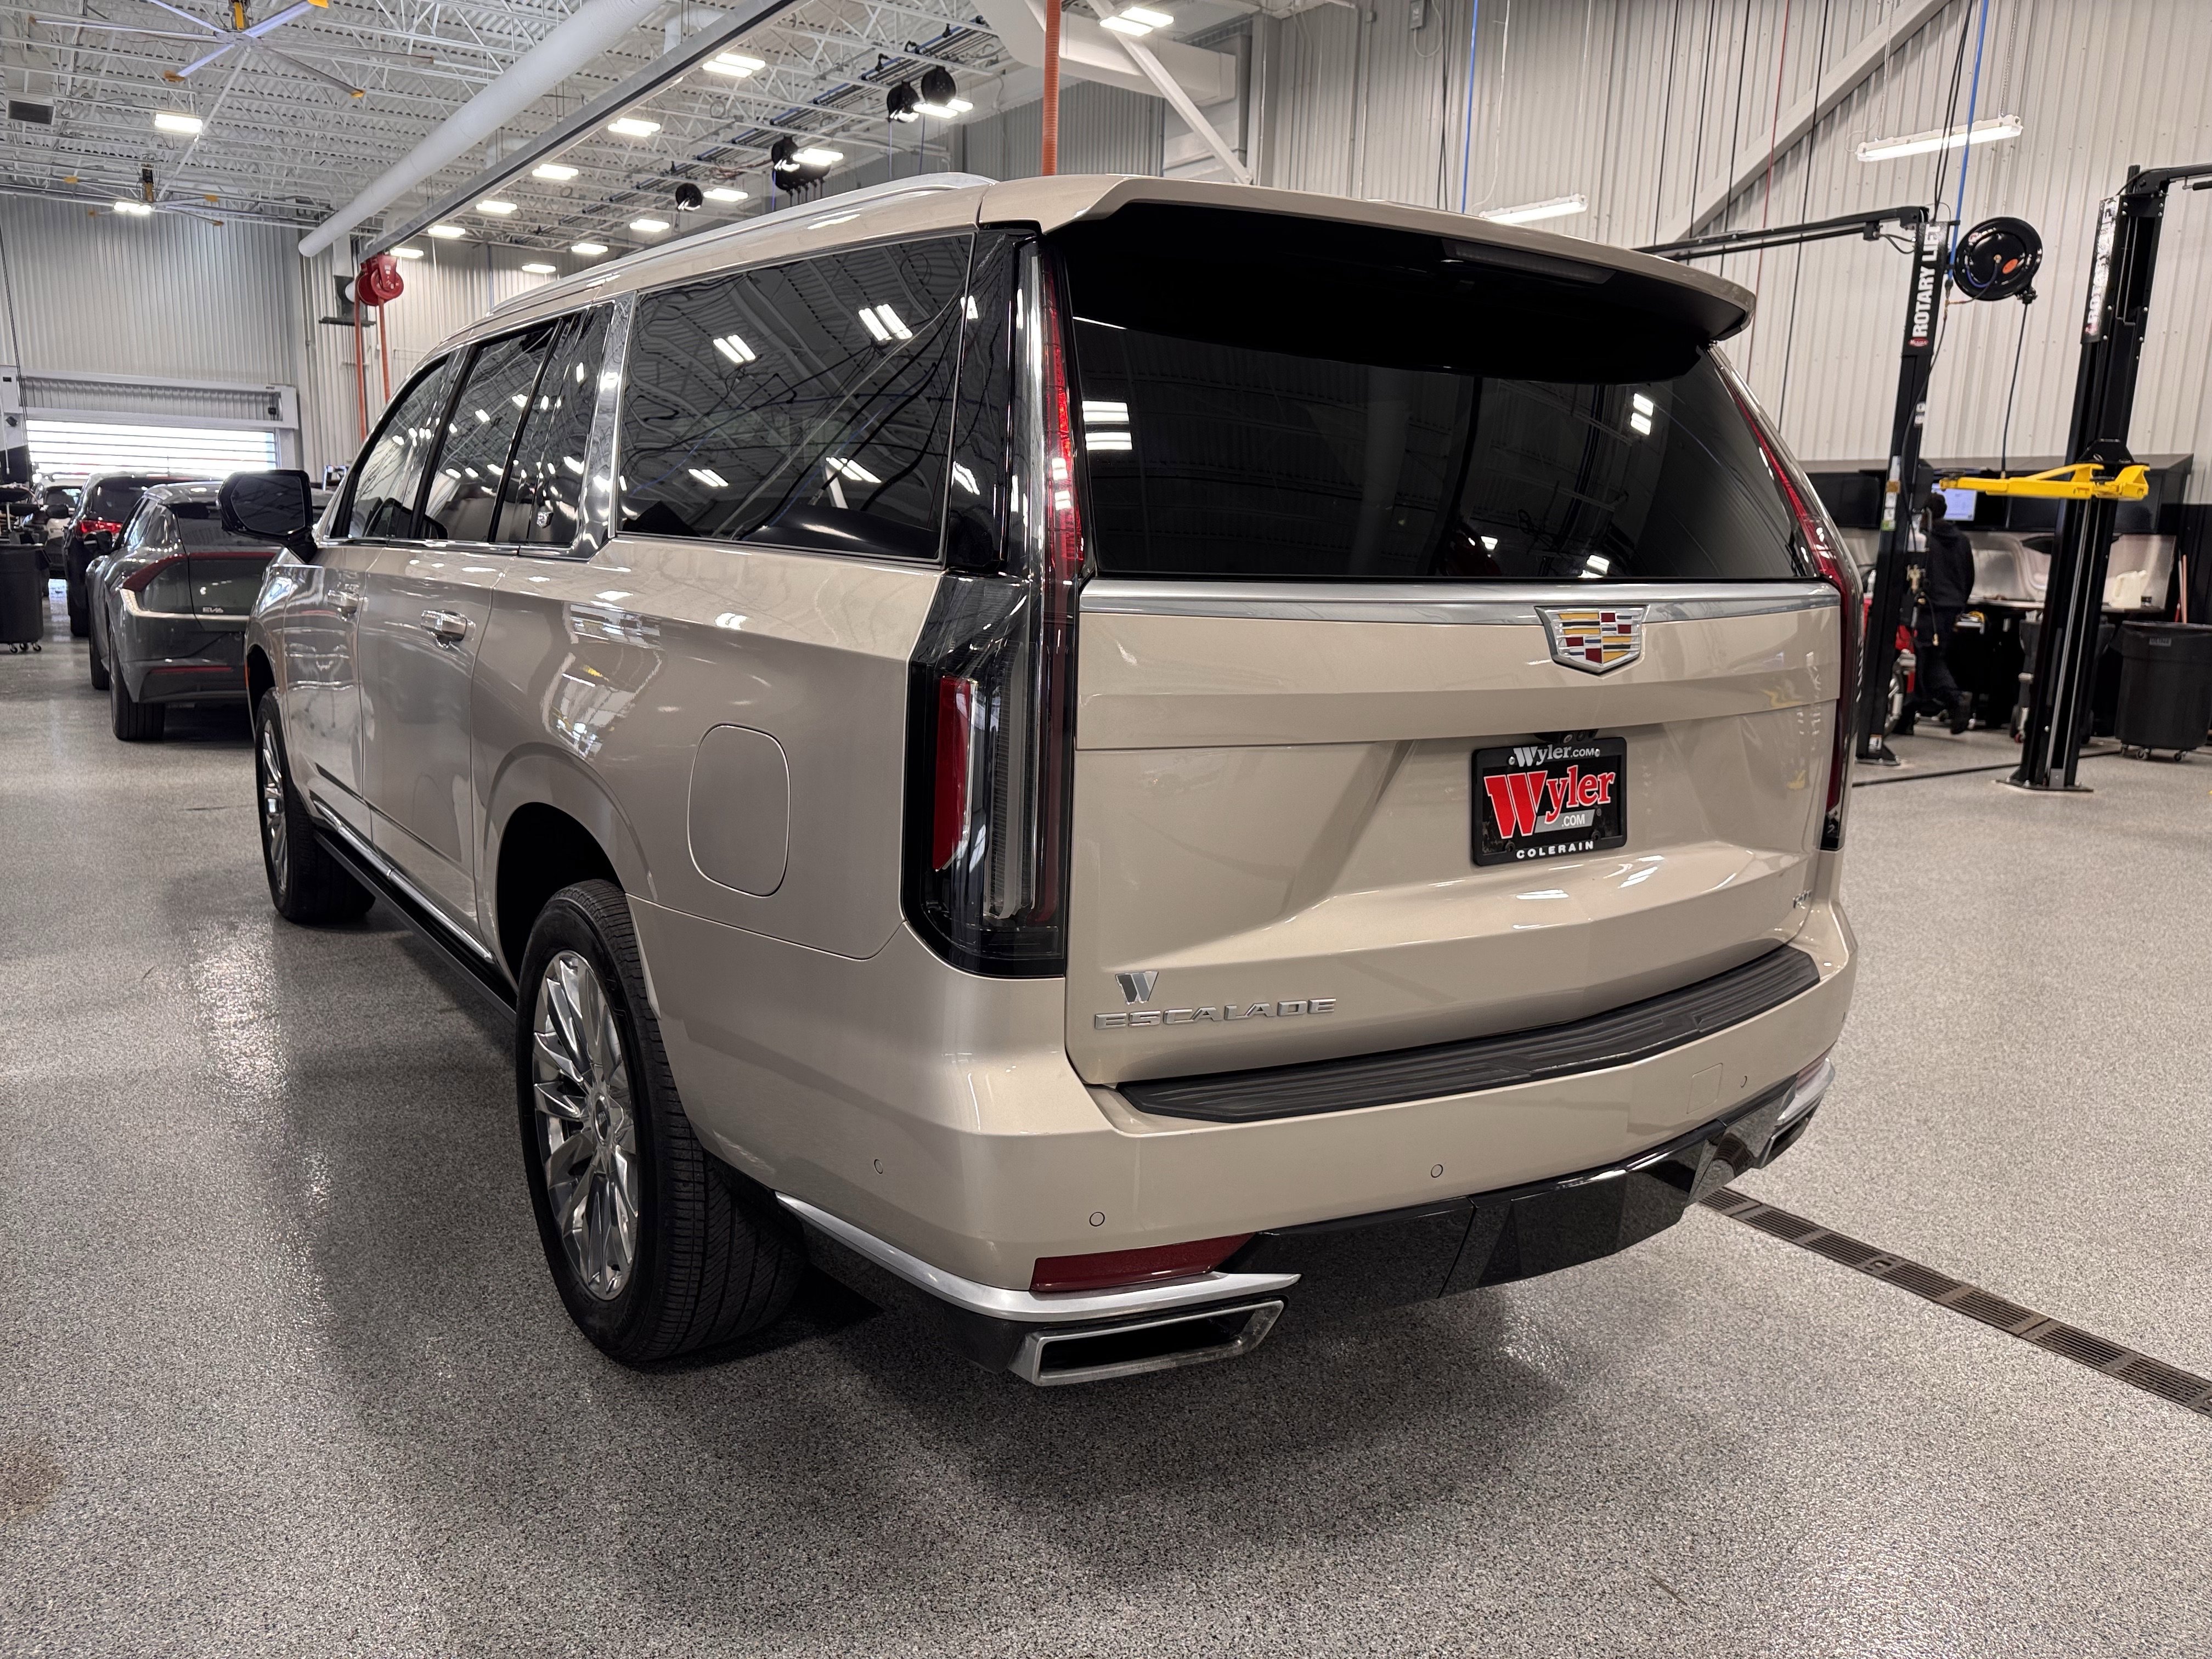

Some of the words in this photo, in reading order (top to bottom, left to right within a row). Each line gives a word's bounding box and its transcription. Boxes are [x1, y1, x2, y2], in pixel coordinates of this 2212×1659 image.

[1922, 223, 1941, 261] LIFT
[1912, 266, 1936, 337] ROTARY
[1483, 764, 1616, 839] Wyler
[1561, 814, 1585, 827] .COM
[1516, 840, 1594, 859] COLERAIN
[1094, 997, 1337, 1029] ESCALADE
